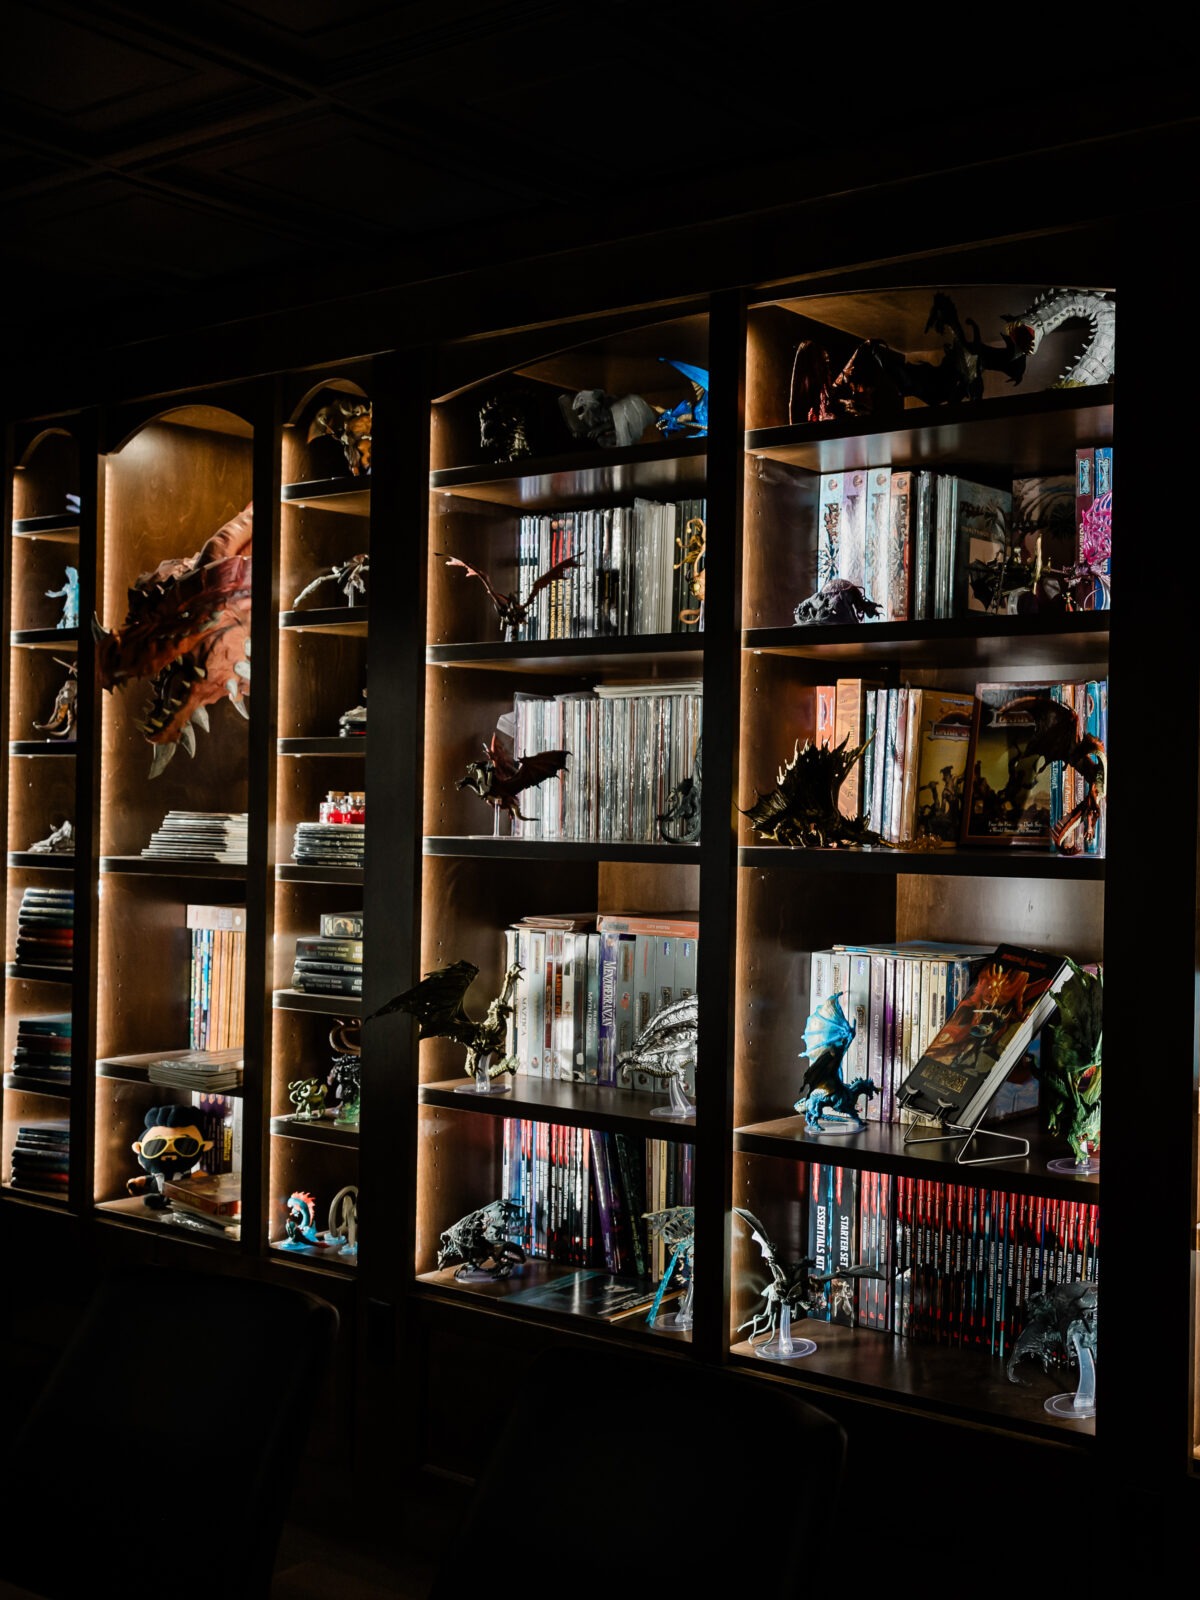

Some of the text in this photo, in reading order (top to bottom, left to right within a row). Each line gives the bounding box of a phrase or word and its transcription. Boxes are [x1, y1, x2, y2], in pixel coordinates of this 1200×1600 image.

[816, 1205, 826, 1271] ESSENTIALS KIT
[840, 1216, 849, 1268] STARTER SET
